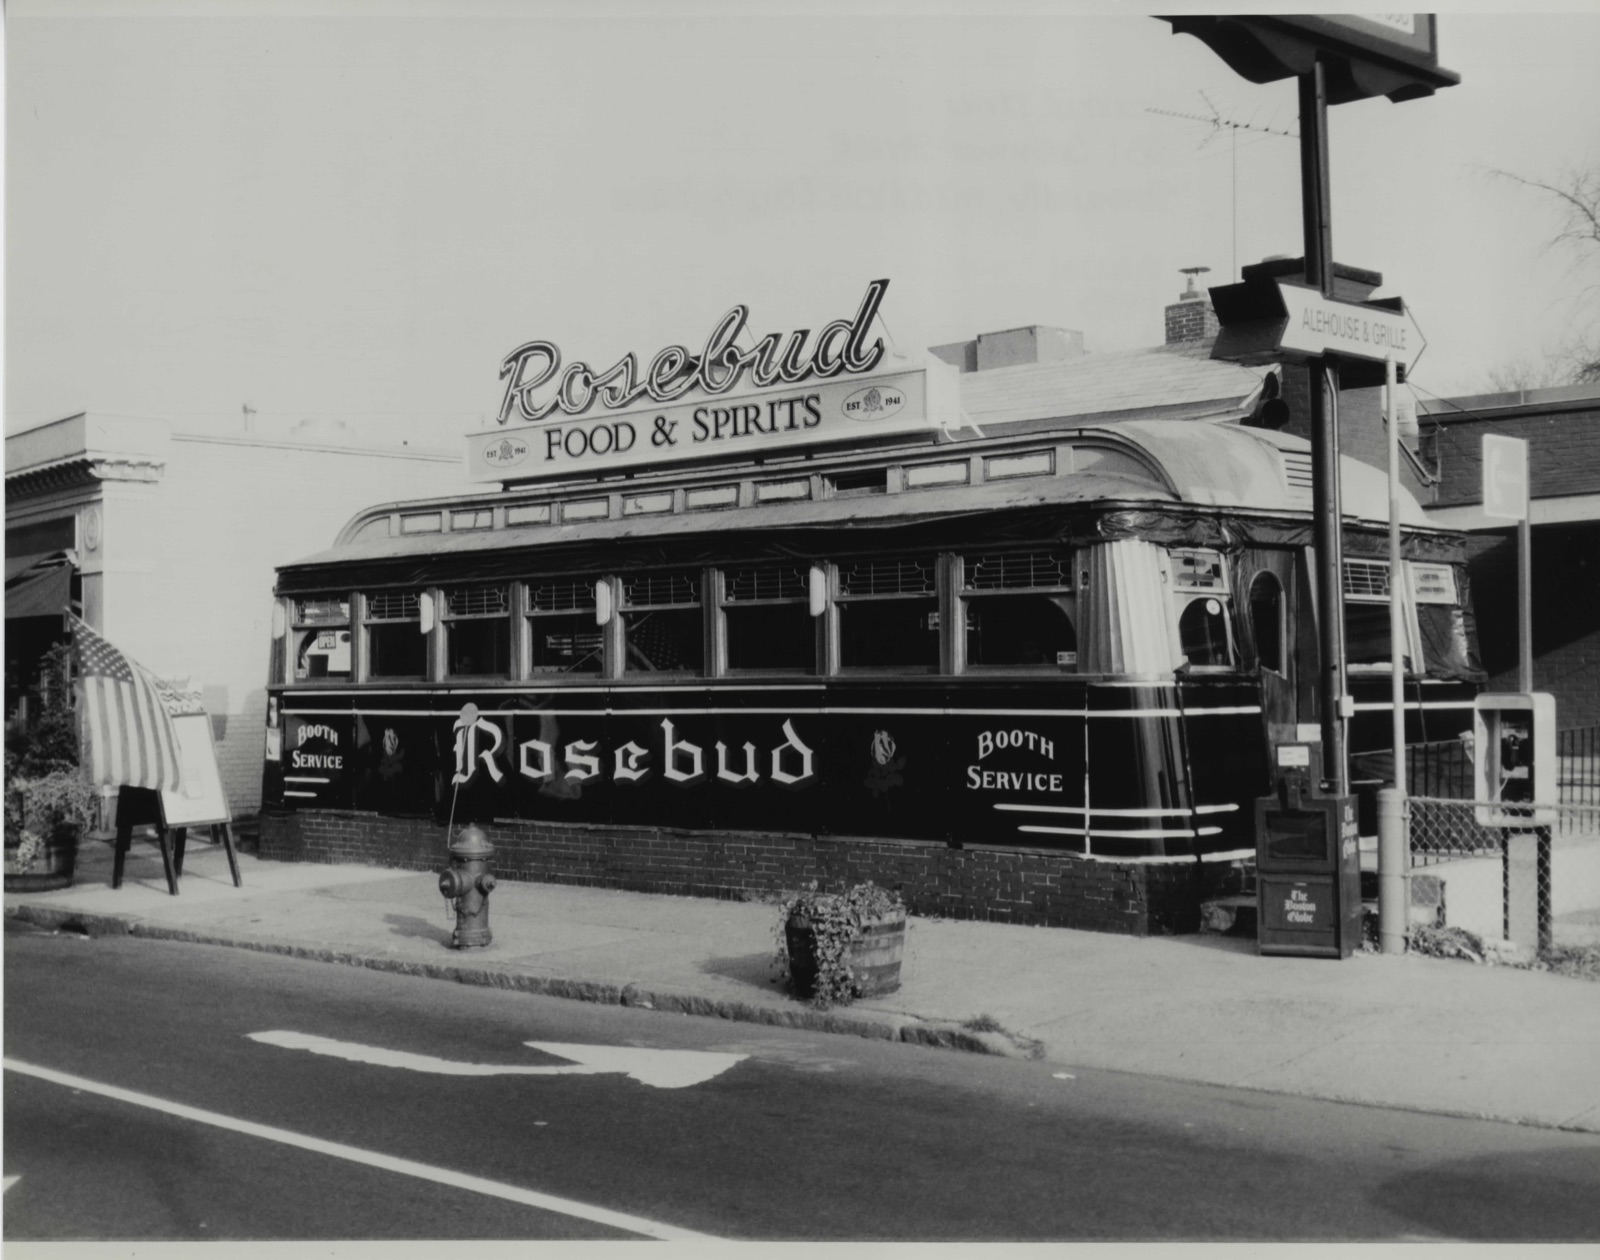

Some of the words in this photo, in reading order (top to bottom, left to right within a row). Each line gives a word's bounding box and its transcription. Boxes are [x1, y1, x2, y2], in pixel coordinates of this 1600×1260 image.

[1302, 307, 1360, 341] ALEHOUSE
[1363, 321, 1370, 343] &
[1372, 322, 1406, 350] GRILLE
[497, 278, 890, 424] Rosebud
[885, 396, 901, 406] 1941
[544, 422, 637, 461] FOOD
[651, 416, 678, 448] &
[692, 394, 822, 444] SPIRITS
[297, 724, 339, 747] BOOTH
[451, 716, 814, 785] Rosebud
[977, 729, 1054, 760] BOOTH
[291, 750, 344, 769] SERVICE
[966, 765, 1063, 792] SERVICE
